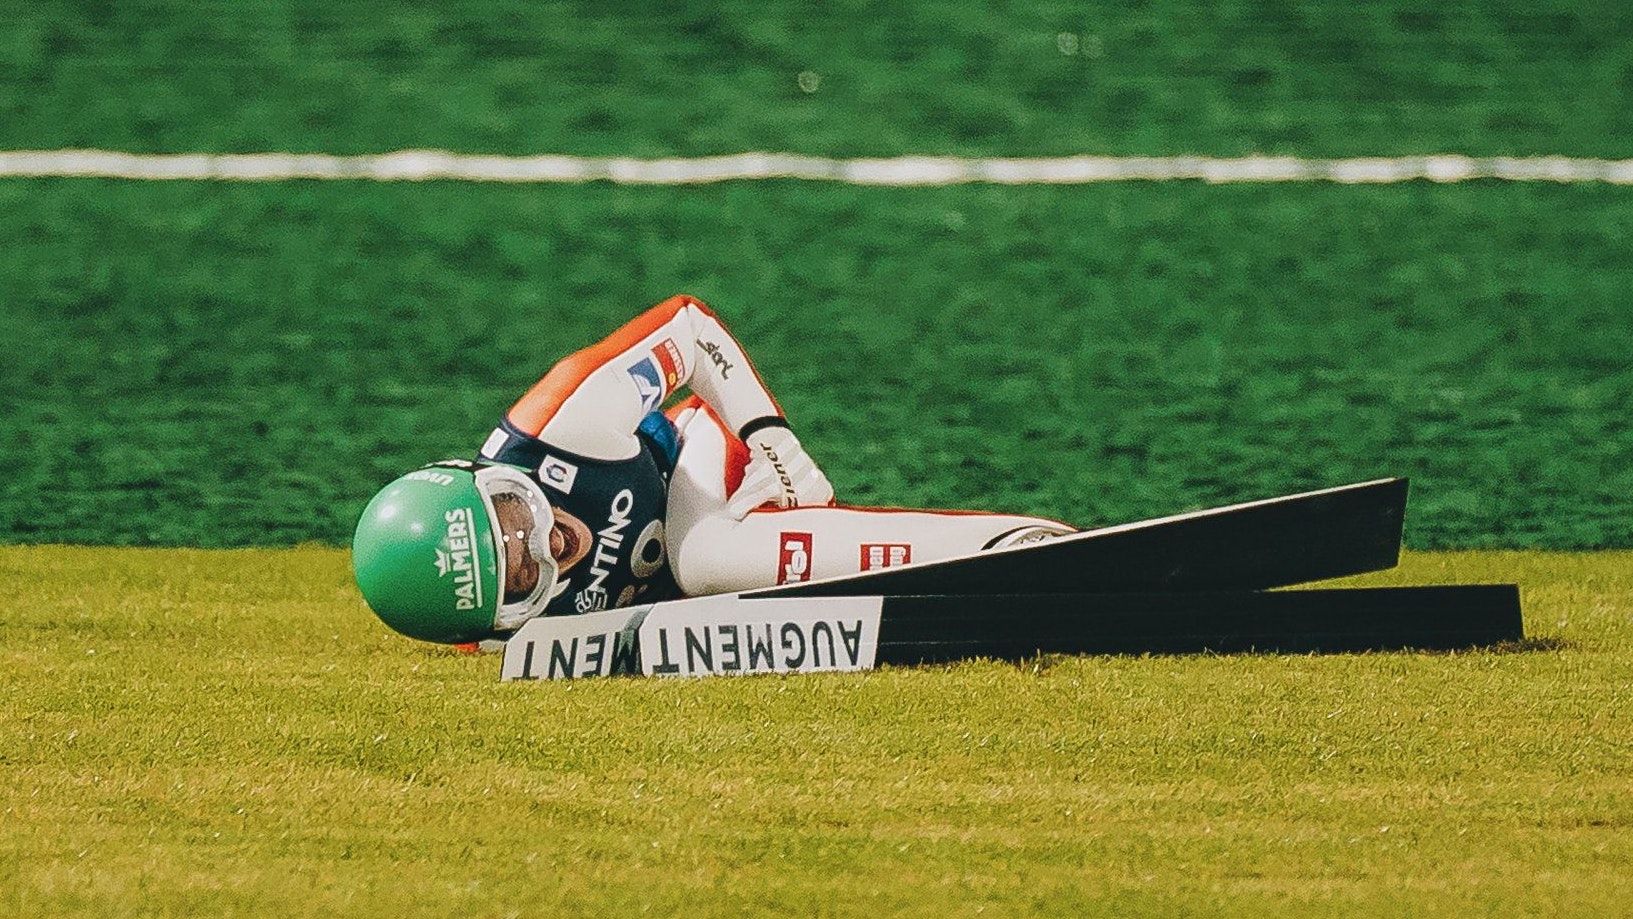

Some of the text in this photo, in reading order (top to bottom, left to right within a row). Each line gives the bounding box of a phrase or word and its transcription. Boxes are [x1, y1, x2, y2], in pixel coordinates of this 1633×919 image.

[445, 508, 475, 610] PALMERS
[513, 631, 641, 680] MENT
[652, 619, 863, 674] AUGMENT
